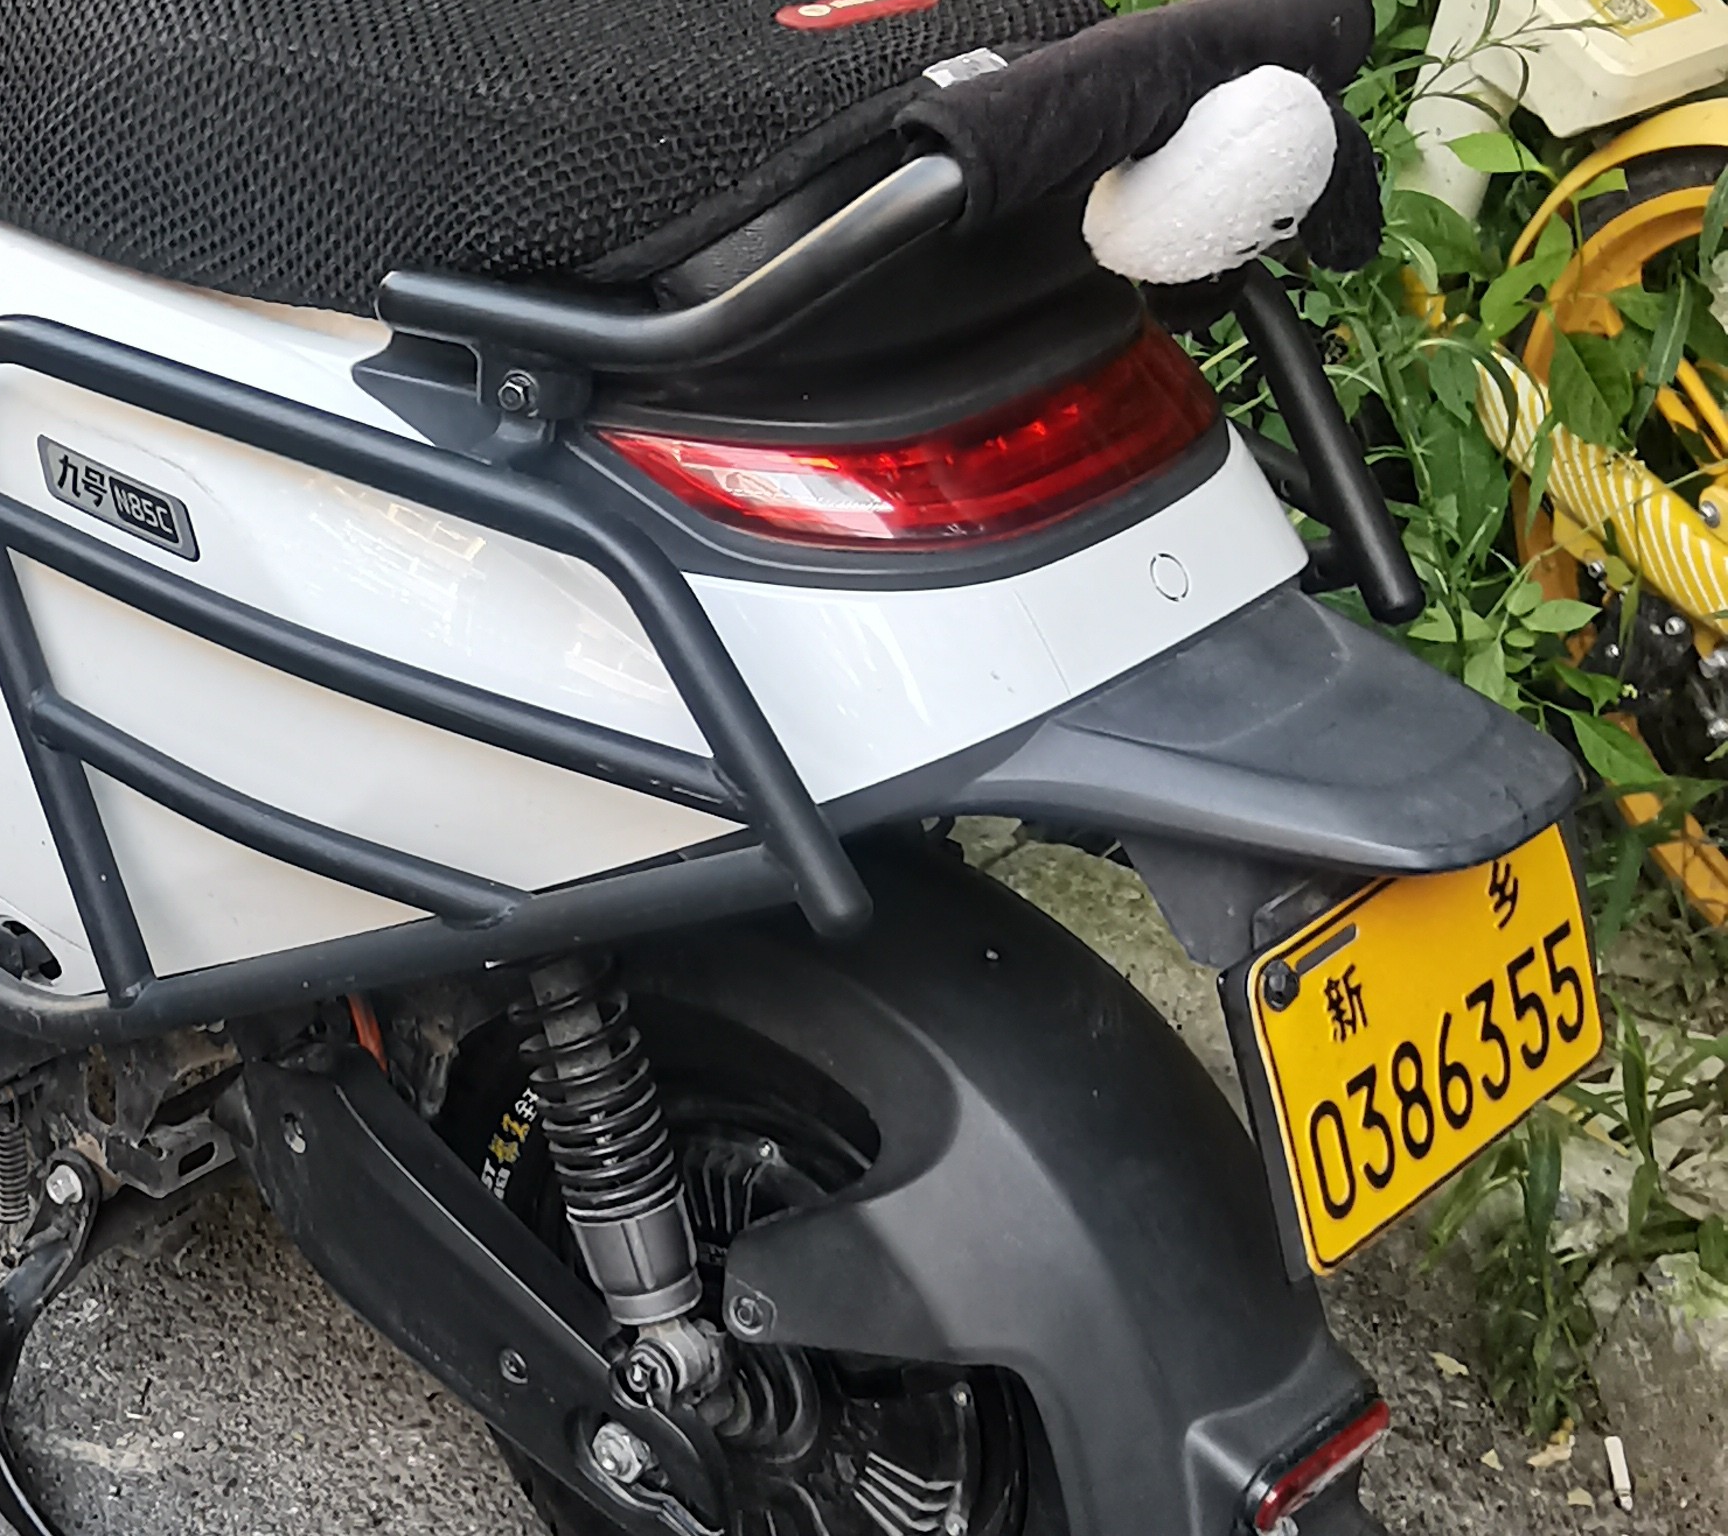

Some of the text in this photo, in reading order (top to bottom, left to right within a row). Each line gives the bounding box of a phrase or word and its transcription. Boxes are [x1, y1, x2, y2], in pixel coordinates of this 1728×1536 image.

[57, 454, 173, 534] 九号 N85C
[1323, 861, 1520, 1043] 新 乡
[1308, 920, 1586, 1220] 0386355
